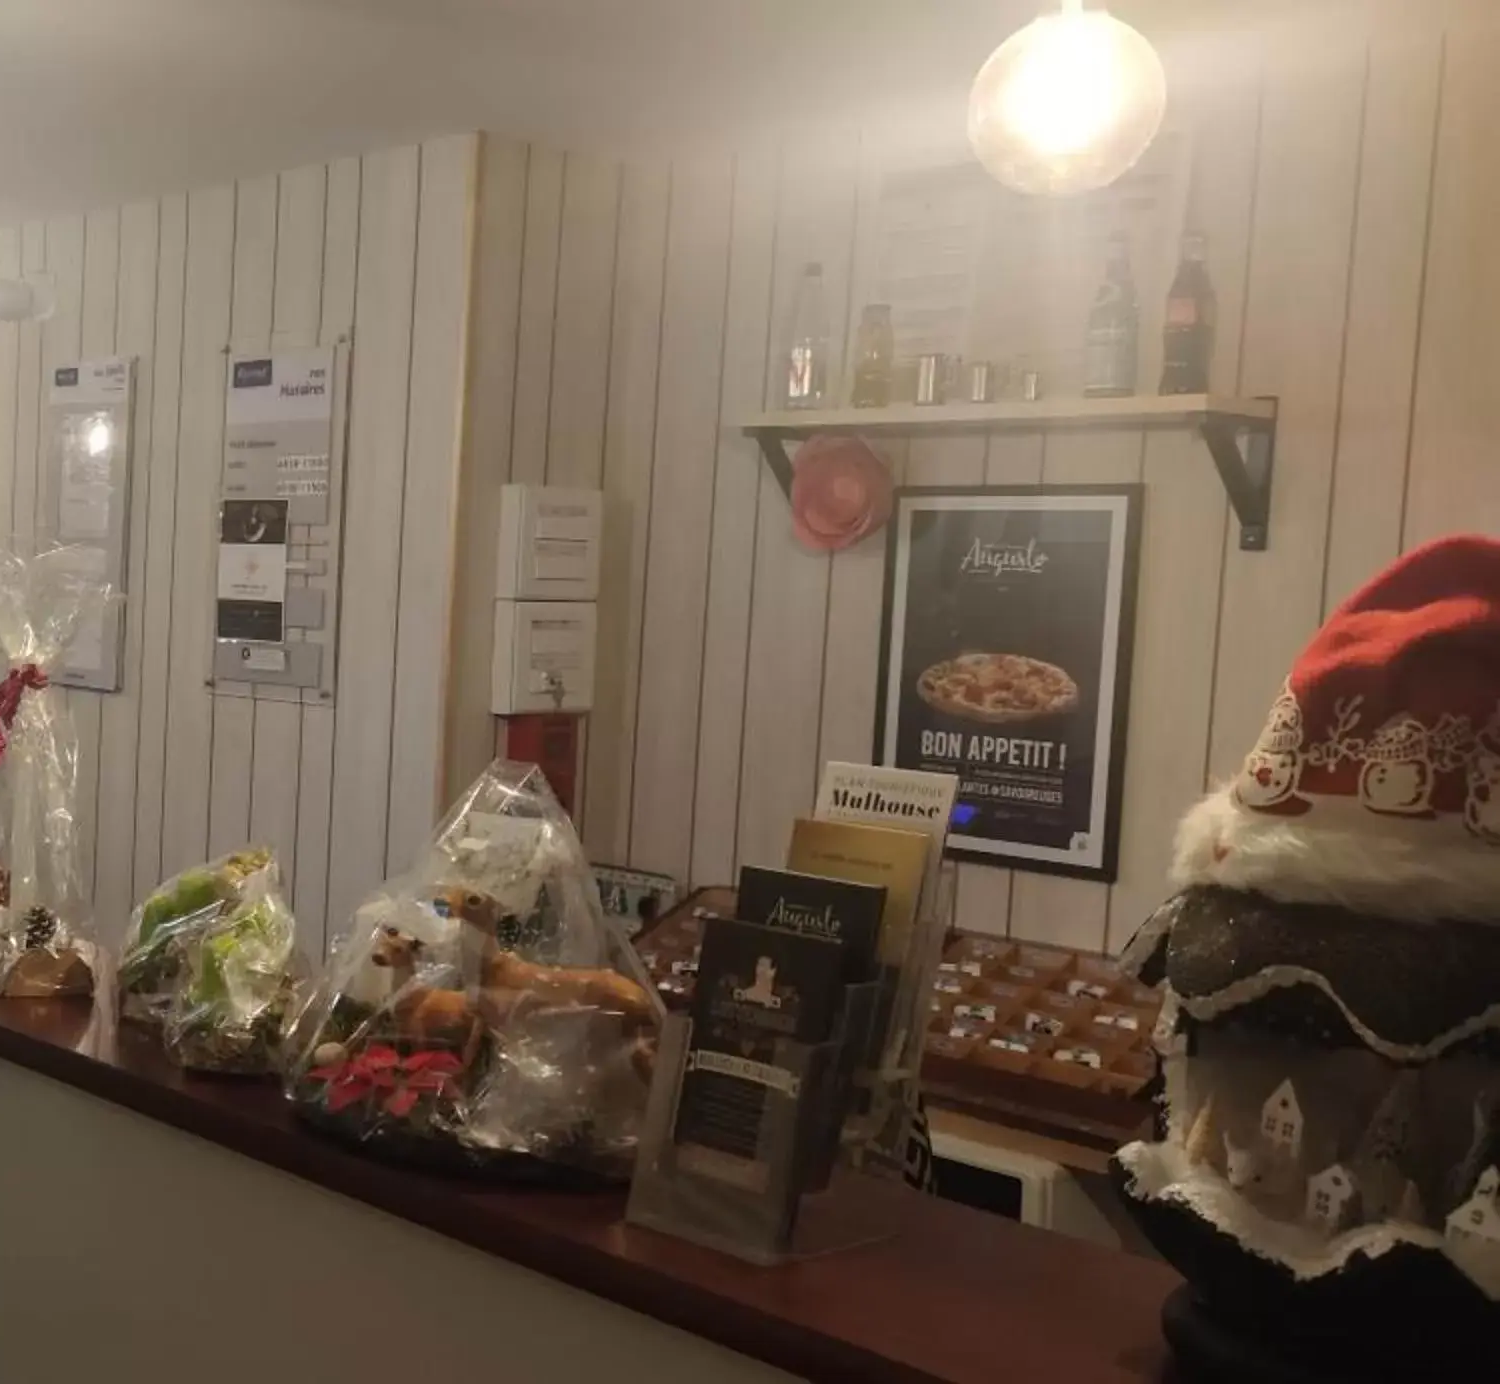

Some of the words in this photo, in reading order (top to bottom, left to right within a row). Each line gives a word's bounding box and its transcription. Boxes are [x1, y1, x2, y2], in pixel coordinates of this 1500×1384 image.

[920, 729, 962, 760] BON
[967, 735, 1054, 769] APPETIT
[1058, 743, 1067, 771] !
[832, 788, 940, 819] Mulhouse
